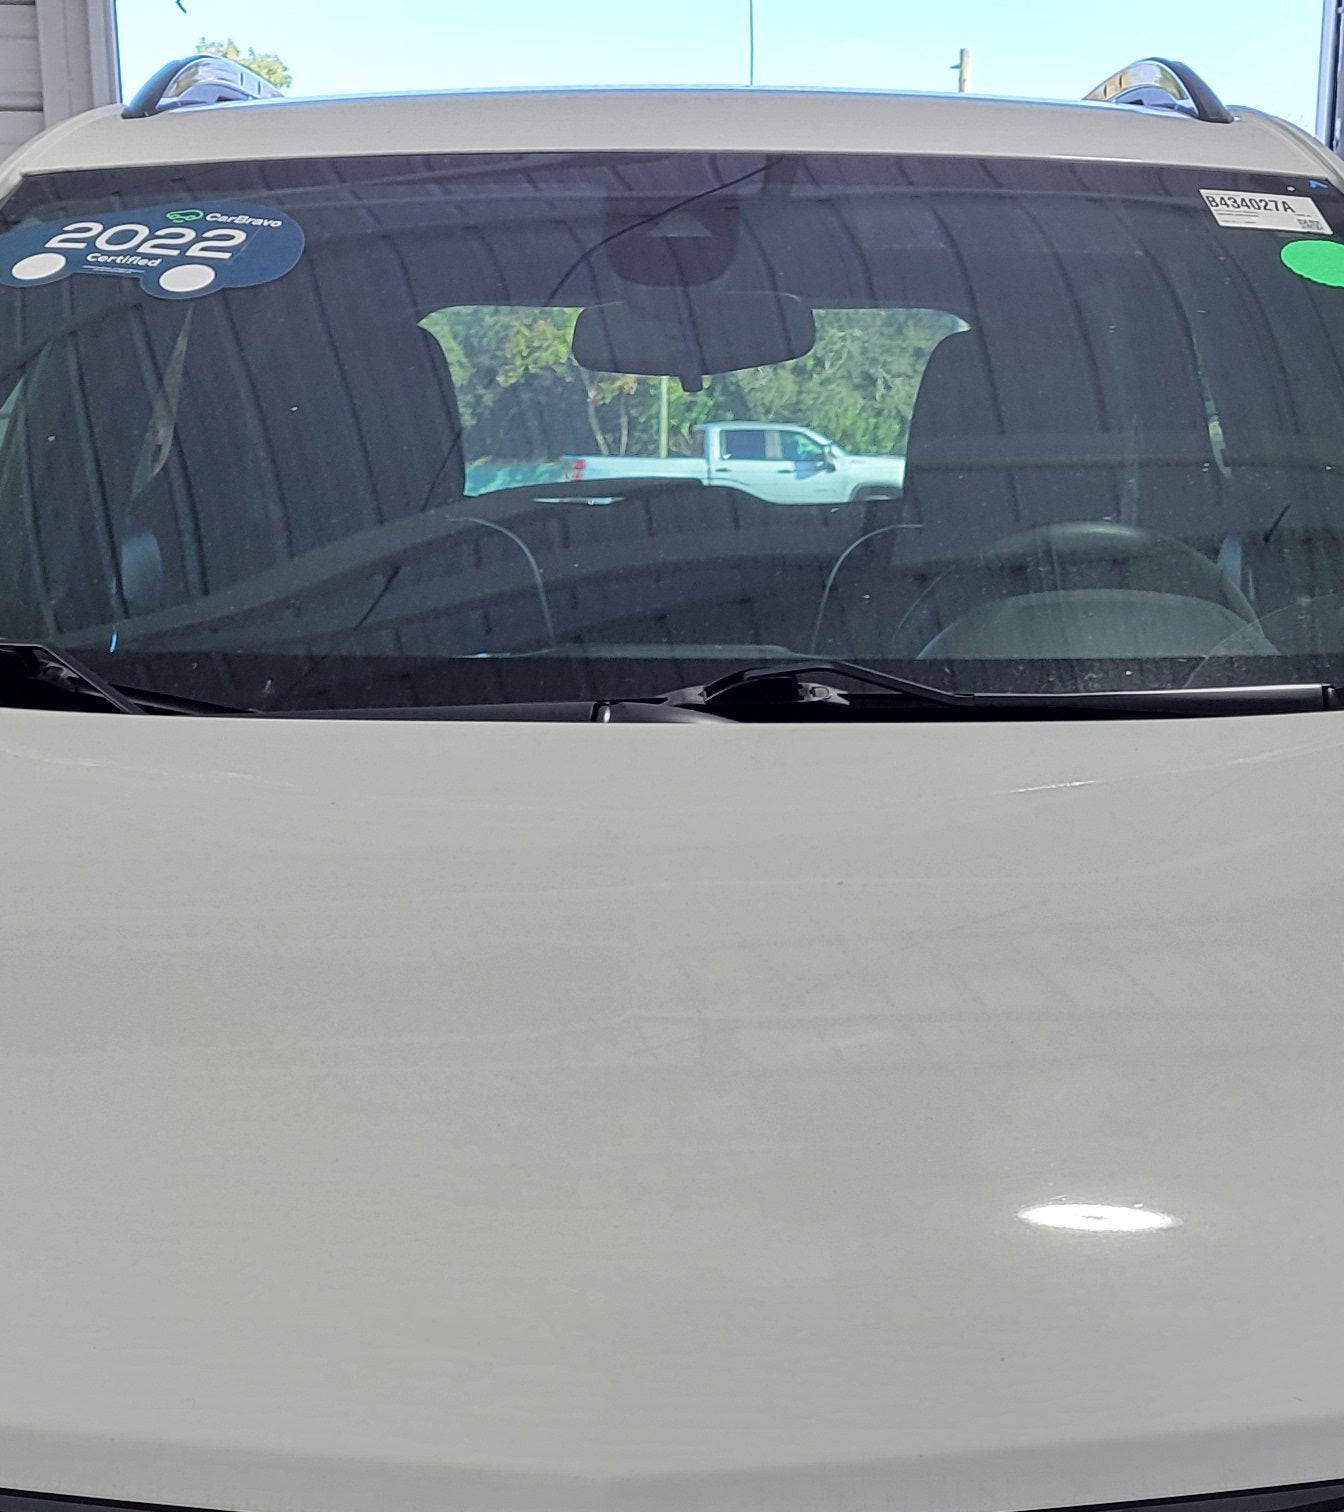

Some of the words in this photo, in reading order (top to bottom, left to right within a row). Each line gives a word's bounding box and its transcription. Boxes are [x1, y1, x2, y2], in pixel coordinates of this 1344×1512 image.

[1205, 195, 1296, 214] B434027A
[204, 211, 283, 228] CarBravo
[43, 221, 247, 259] 2022
[85, 252, 162, 267] Certified
